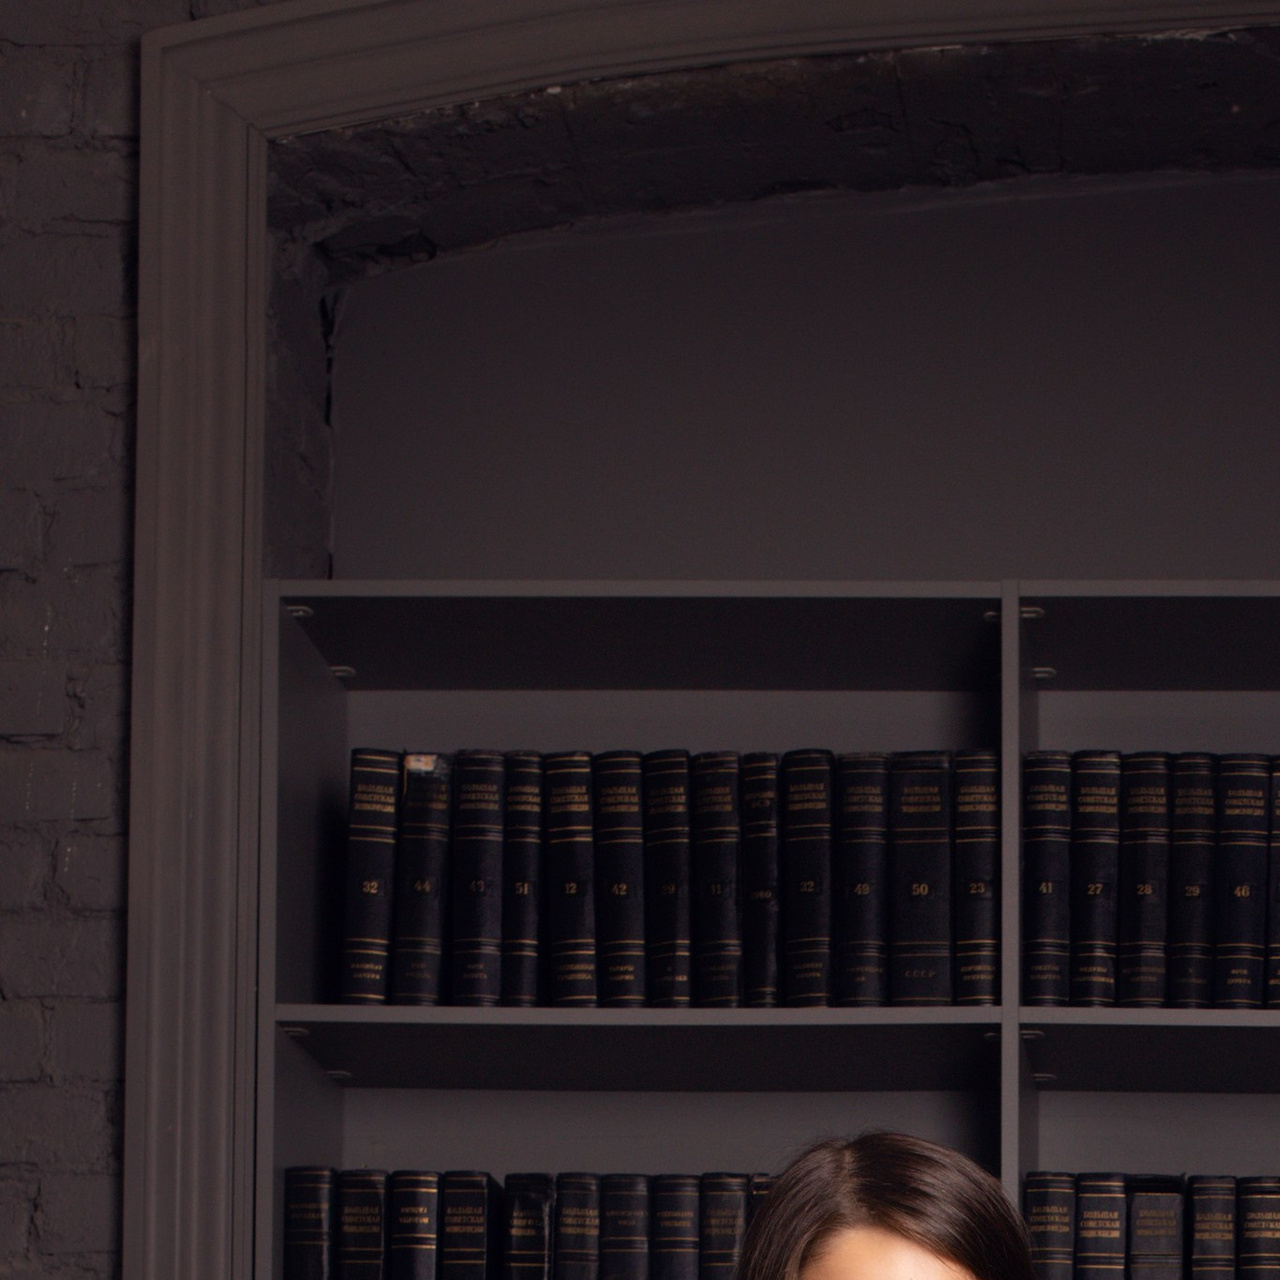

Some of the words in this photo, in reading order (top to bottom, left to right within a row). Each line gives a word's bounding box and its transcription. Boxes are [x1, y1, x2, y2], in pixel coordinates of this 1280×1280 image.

[362, 881, 378, 895] 32
[514, 882, 530, 896] 51
[912, 883, 929, 896] 50
[969, 882, 986, 894] 23
[1039, 882, 1054, 894] 41
[1087, 884, 1104, 895] 27
